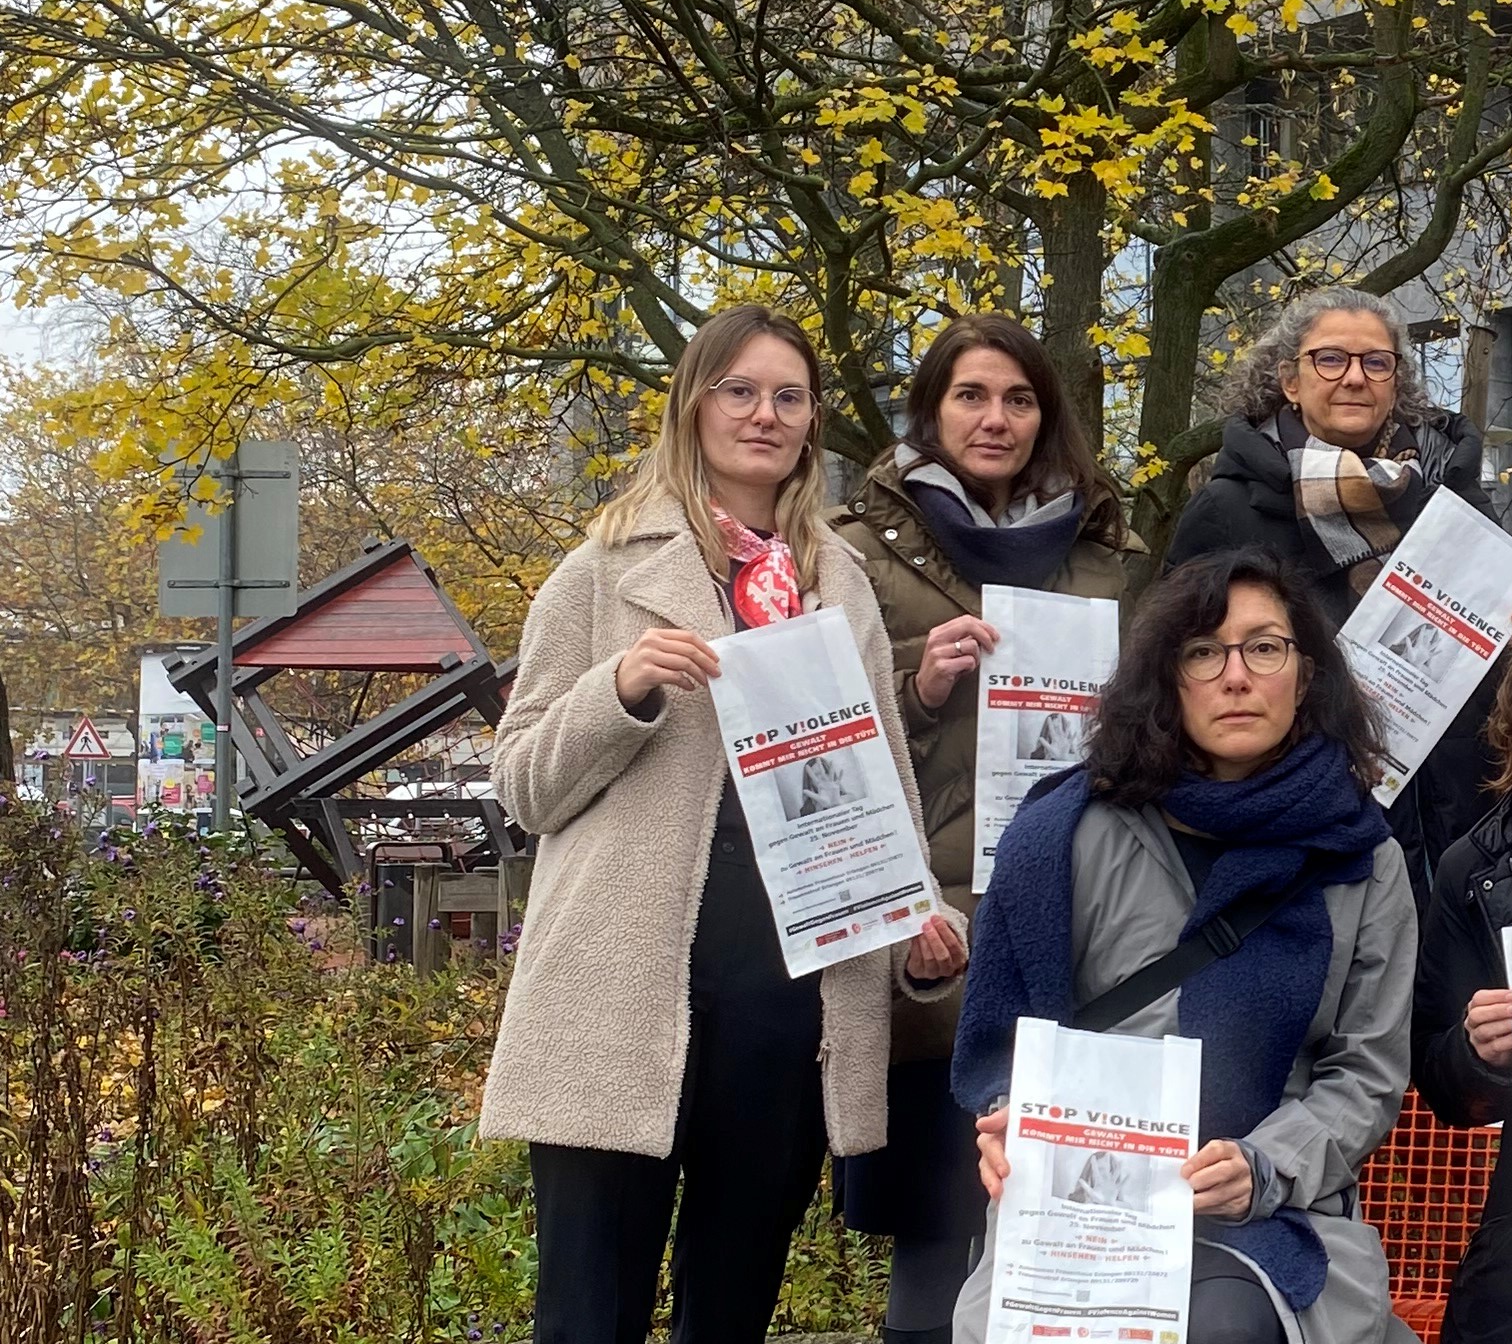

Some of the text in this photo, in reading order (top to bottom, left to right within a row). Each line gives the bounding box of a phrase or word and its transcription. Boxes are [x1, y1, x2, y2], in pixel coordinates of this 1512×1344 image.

[1395, 561, 1432, 590] STOP
[1426, 601, 1455, 624] GEWALT
[1426, 610, 1448, 628] NICHT
[1470, 640, 1489, 657] TÜTE
[989, 675, 1100, 693] STOP V!OLEN
[734, 729, 779, 752] STOP
[743, 727, 876, 774] KOMMT MIR NICHT IN DIE TÜTE
[789, 734, 827, 750] GEWALT
[1021, 1101, 1077, 1120] STOP
[1022, 1128, 1061, 1140] KOMMT
[1064, 1134, 1084, 1143] MIR
[1088, 1138, 1119, 1148] NICHT
[1123, 1142, 1134, 1150] IN
[1158, 1147, 1185, 1155] TÜTE
[1082, 1128, 1125, 1140] GEWALT
